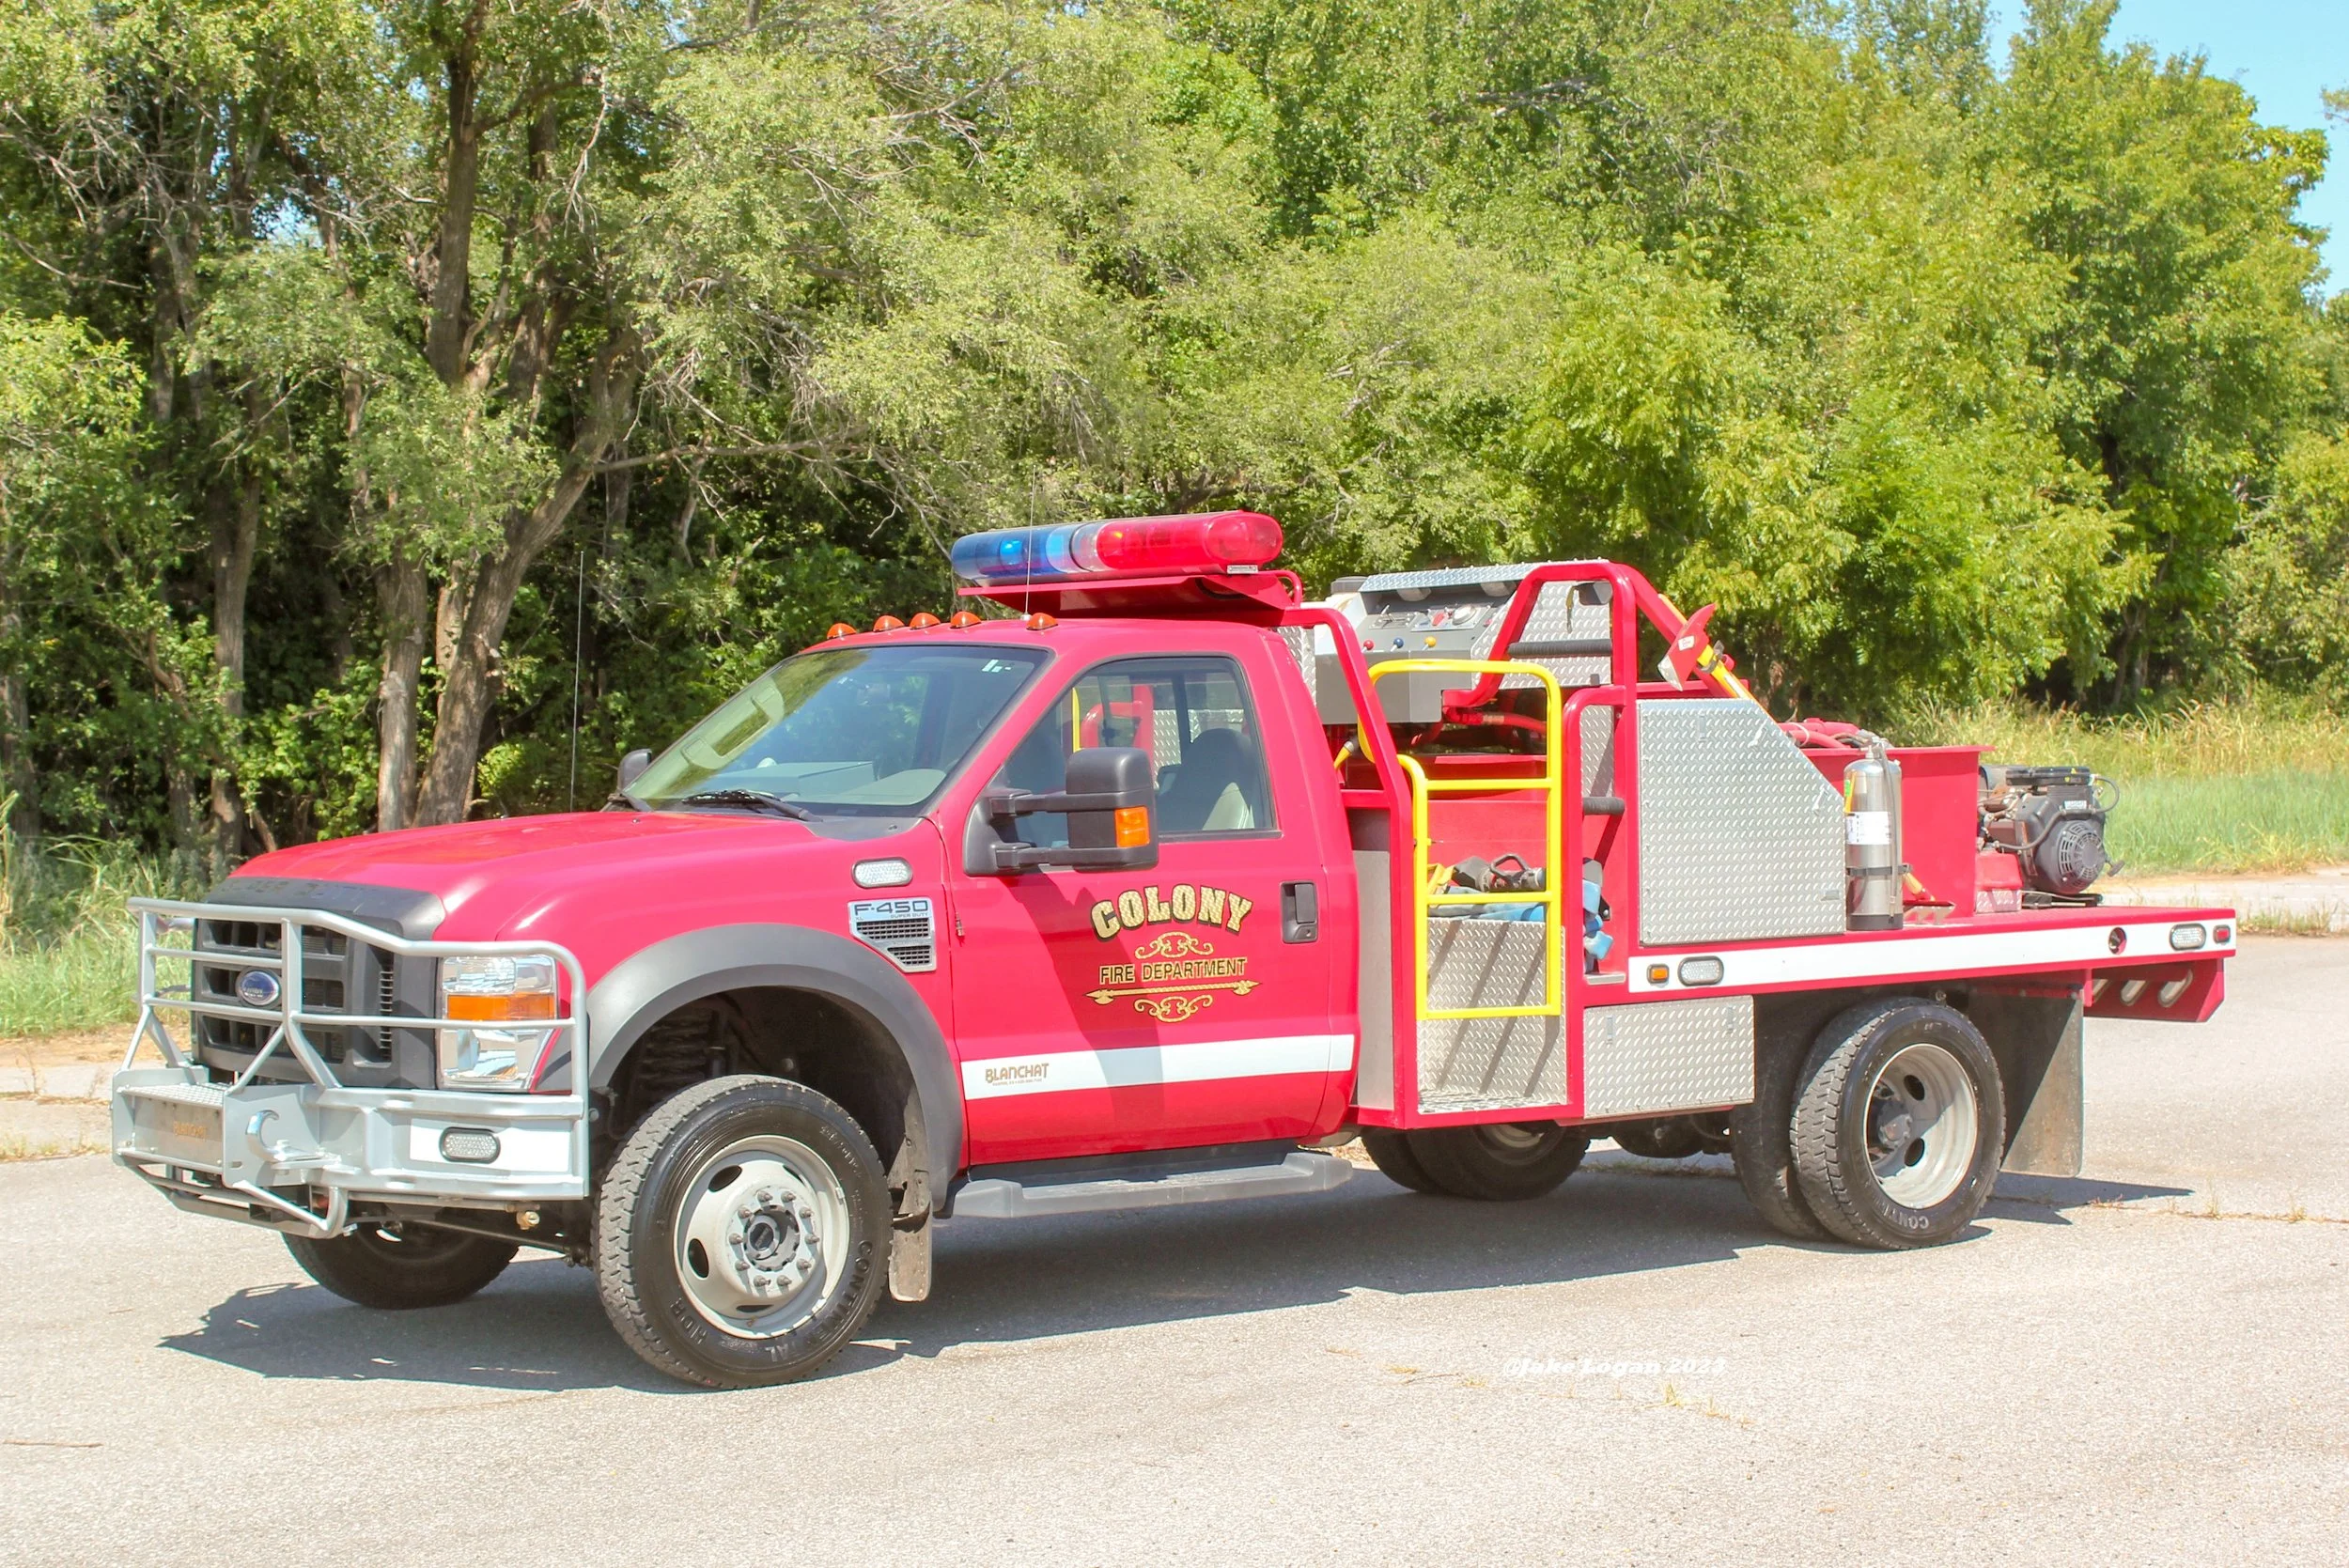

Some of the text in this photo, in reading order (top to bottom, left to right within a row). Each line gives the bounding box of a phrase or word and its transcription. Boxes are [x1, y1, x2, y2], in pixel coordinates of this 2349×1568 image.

[854, 900, 928, 916] F-450
[1091, 883, 1253, 942] COLONY
[1099, 957, 1248, 985] FIRE DEPARTMENT
[985, 1063, 1050, 1083] BLANCHAT
